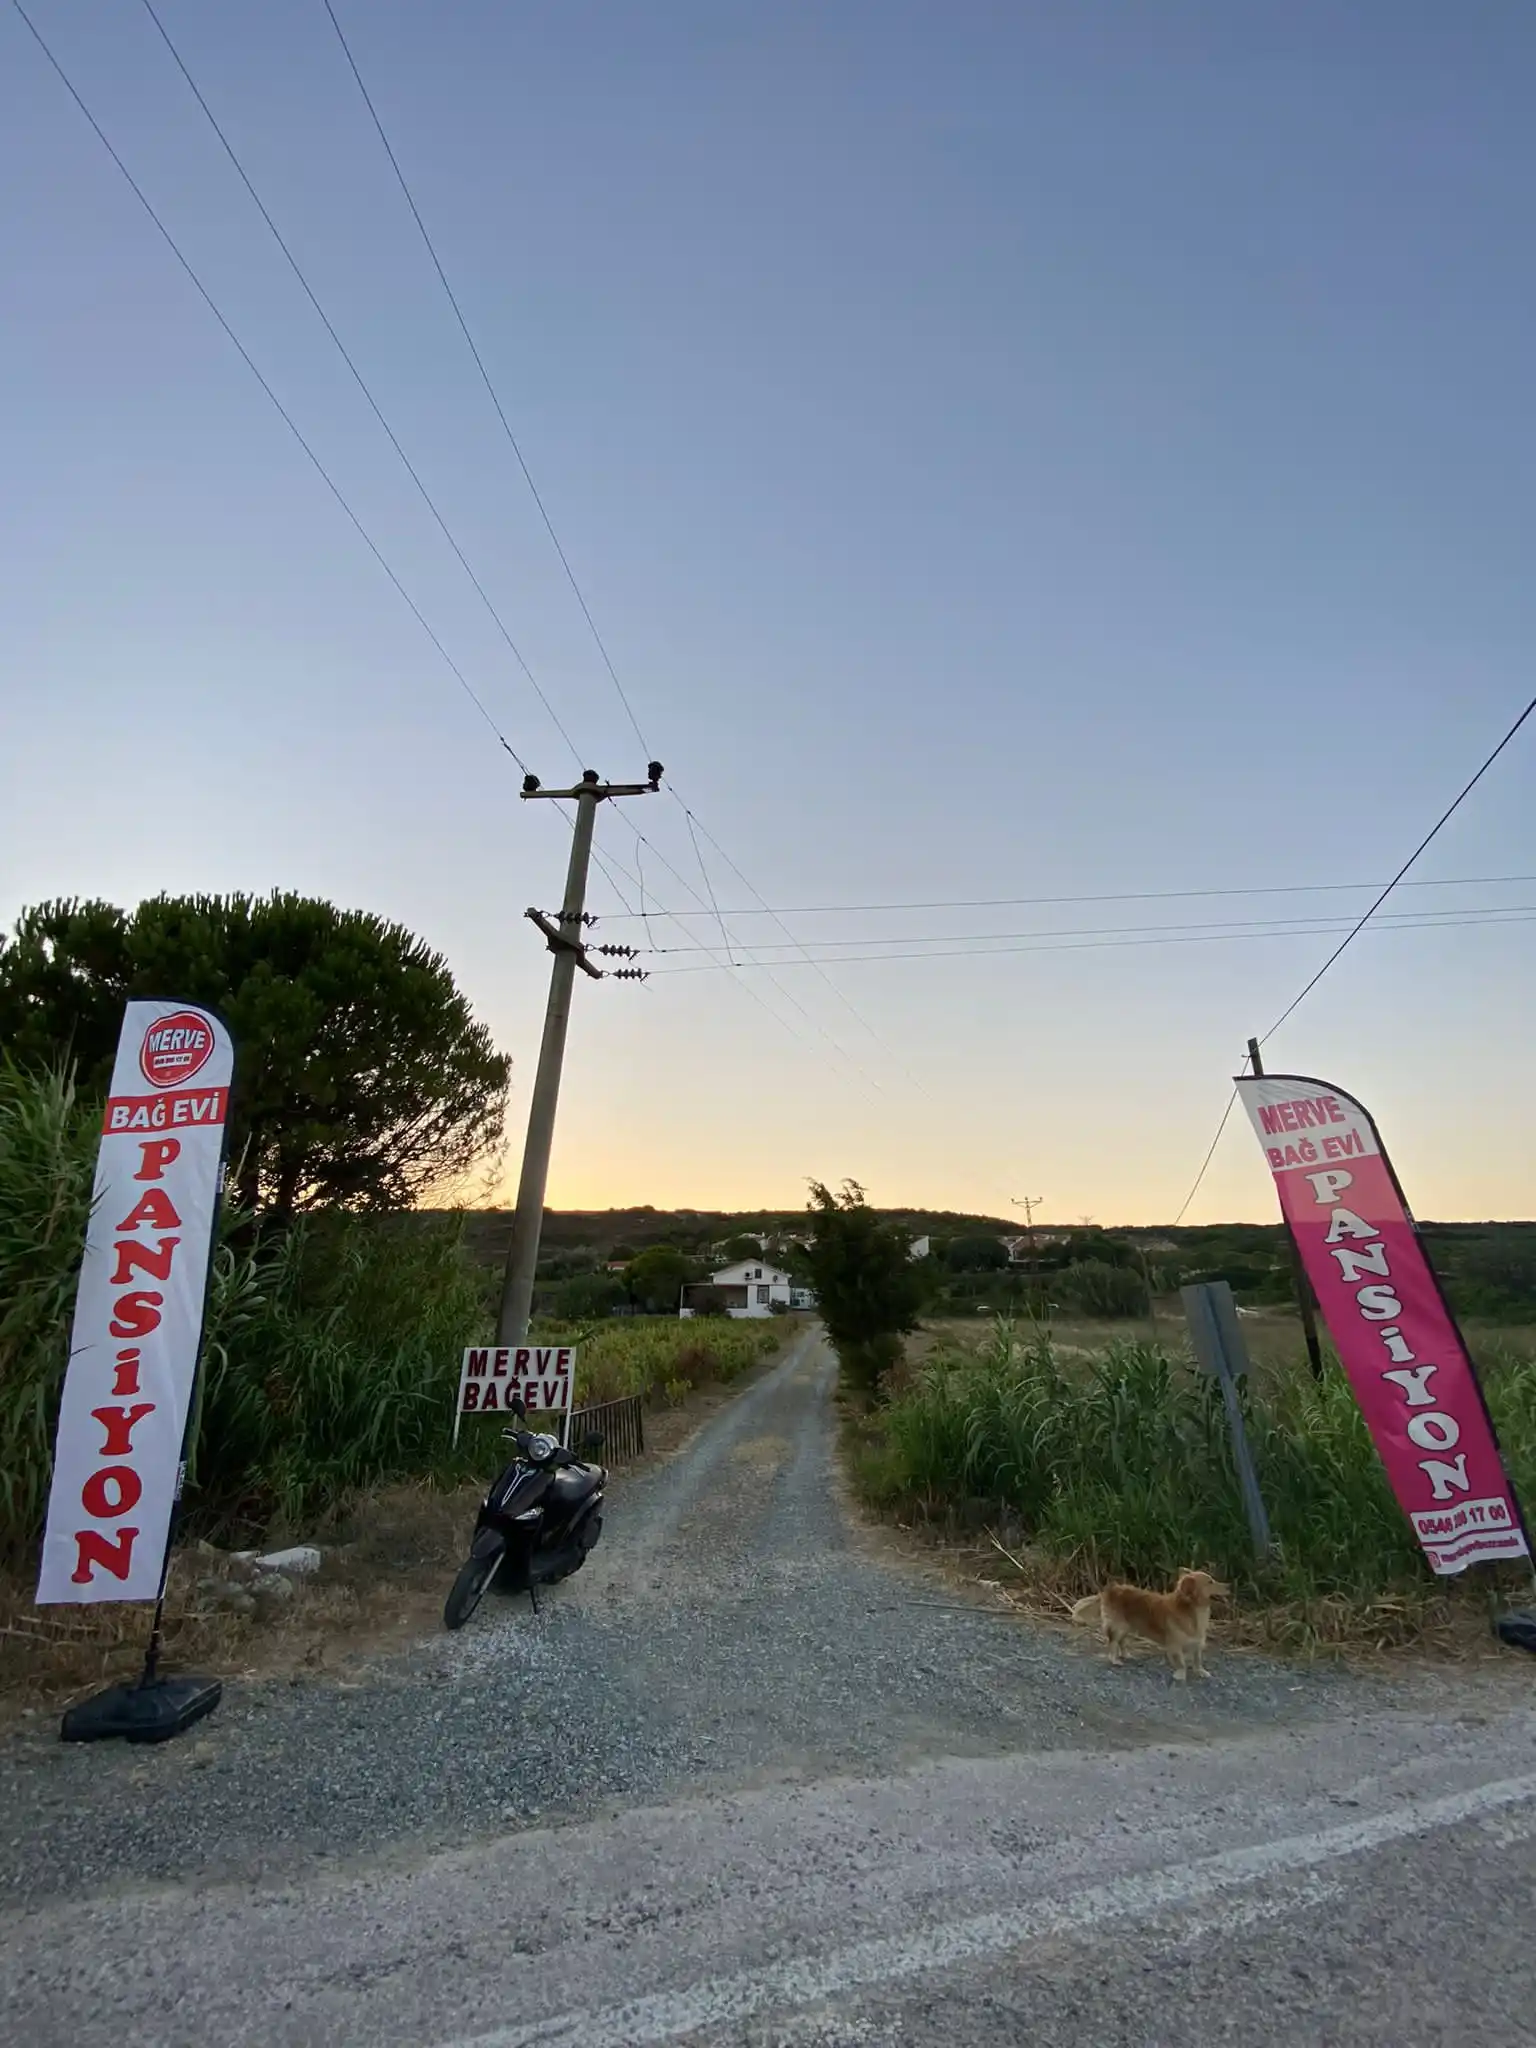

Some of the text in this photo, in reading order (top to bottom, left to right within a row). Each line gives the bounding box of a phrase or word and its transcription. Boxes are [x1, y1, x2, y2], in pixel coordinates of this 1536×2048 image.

[149, 1028, 206, 1053] MERVE
[110, 1091, 221, 1130] BAĞ EVİ
[1257, 1095, 1346, 1135] MERVE
[1266, 1137, 1318, 1168] BAĞ
[467, 1349, 571, 1377] MERVE
[1469, 1506, 1485, 1523] 17
